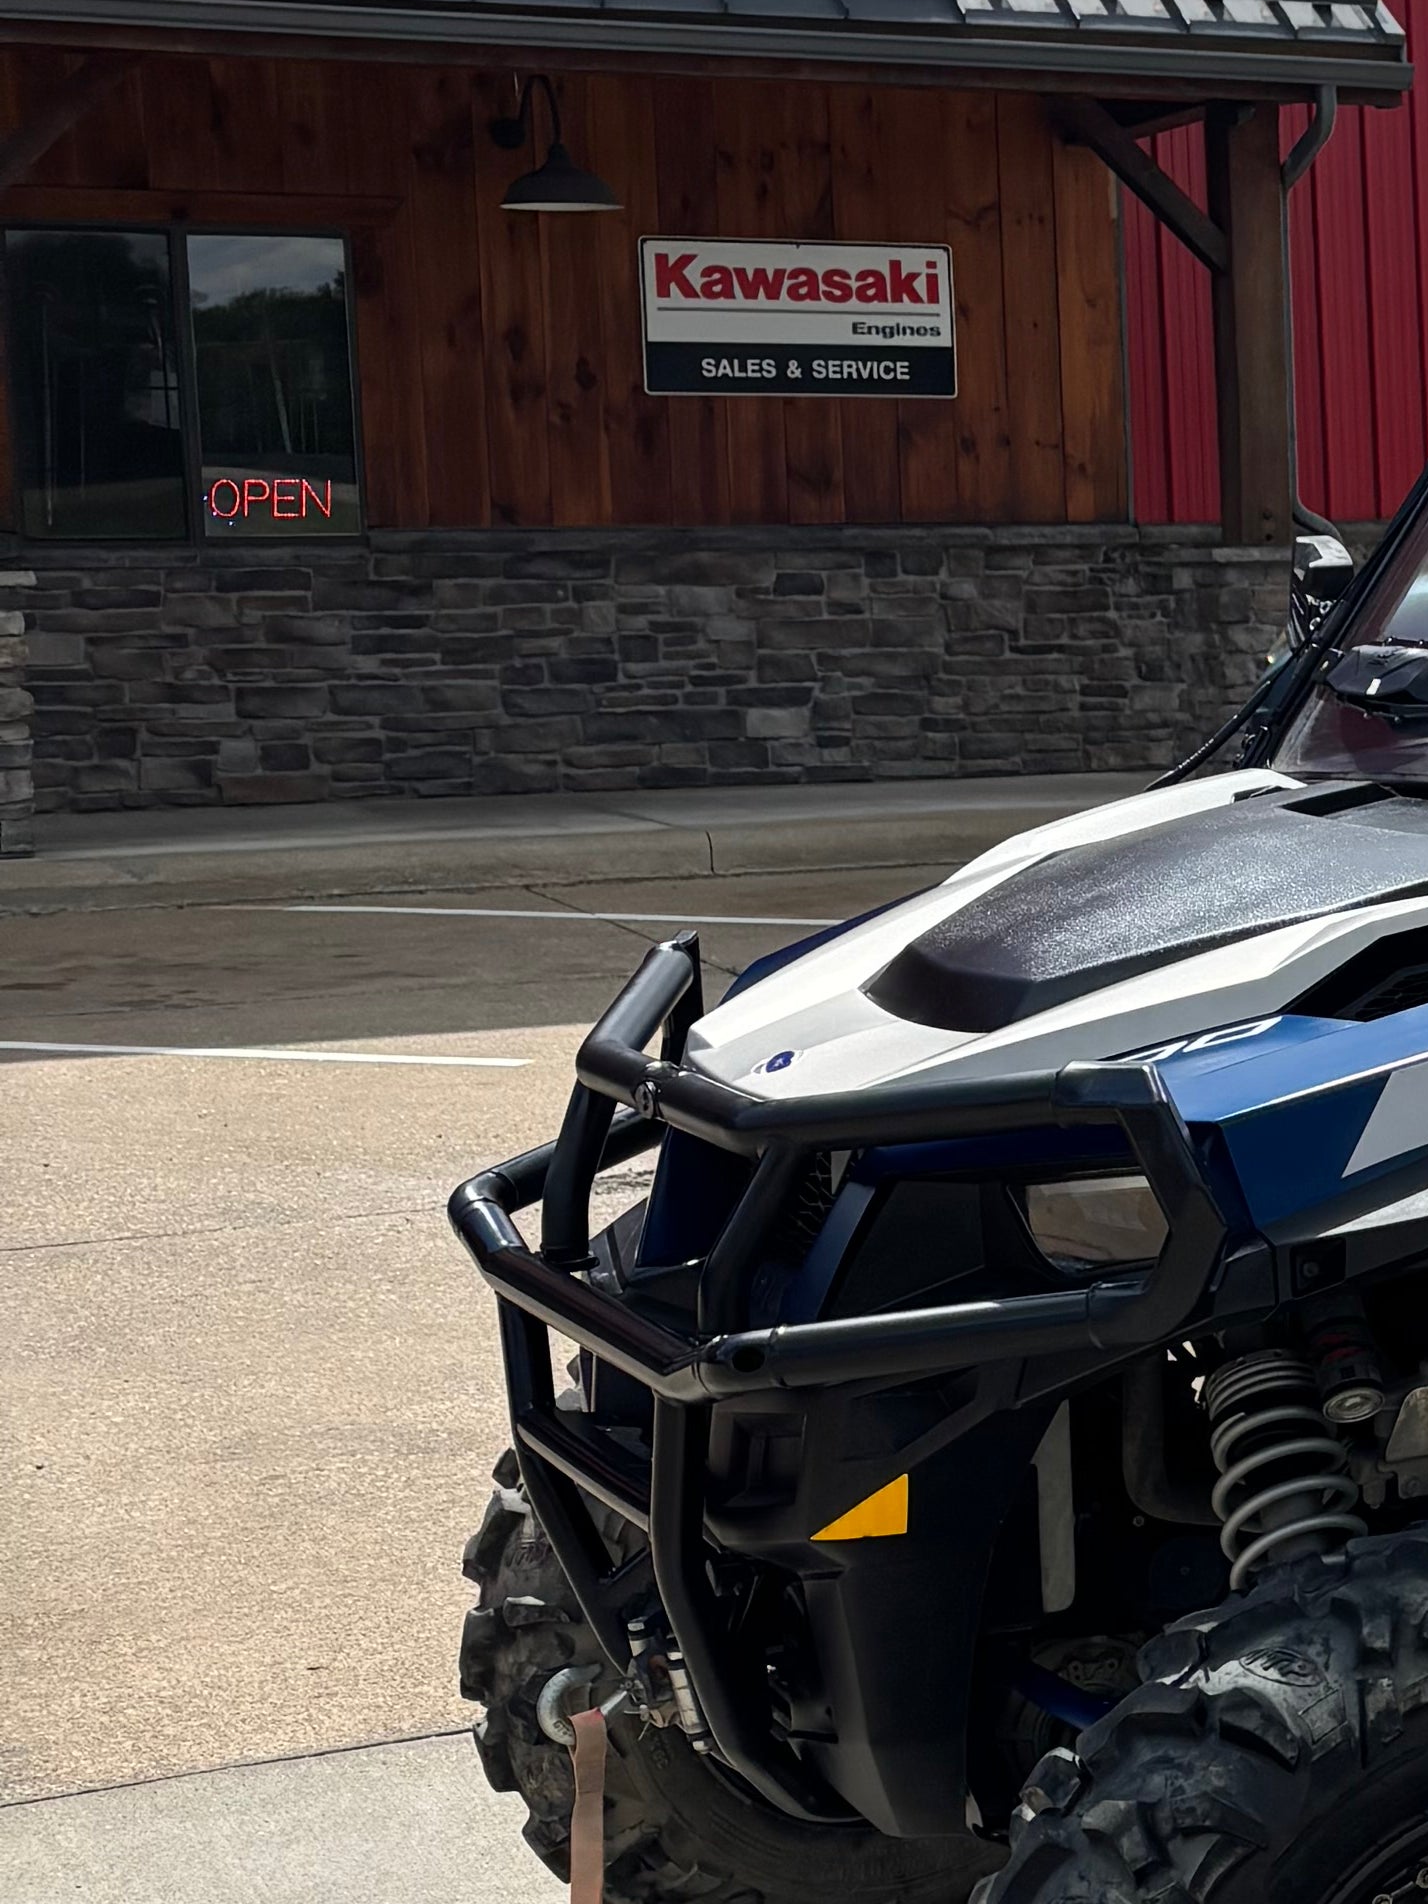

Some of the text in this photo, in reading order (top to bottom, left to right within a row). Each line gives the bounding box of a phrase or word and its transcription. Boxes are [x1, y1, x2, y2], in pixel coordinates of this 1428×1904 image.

[654, 253, 940, 304] Kawasaki
[851, 321, 941, 339] Engines
[702, 357, 911, 381] SALES & SERVICE
[210, 479, 331, 517] OPEN
